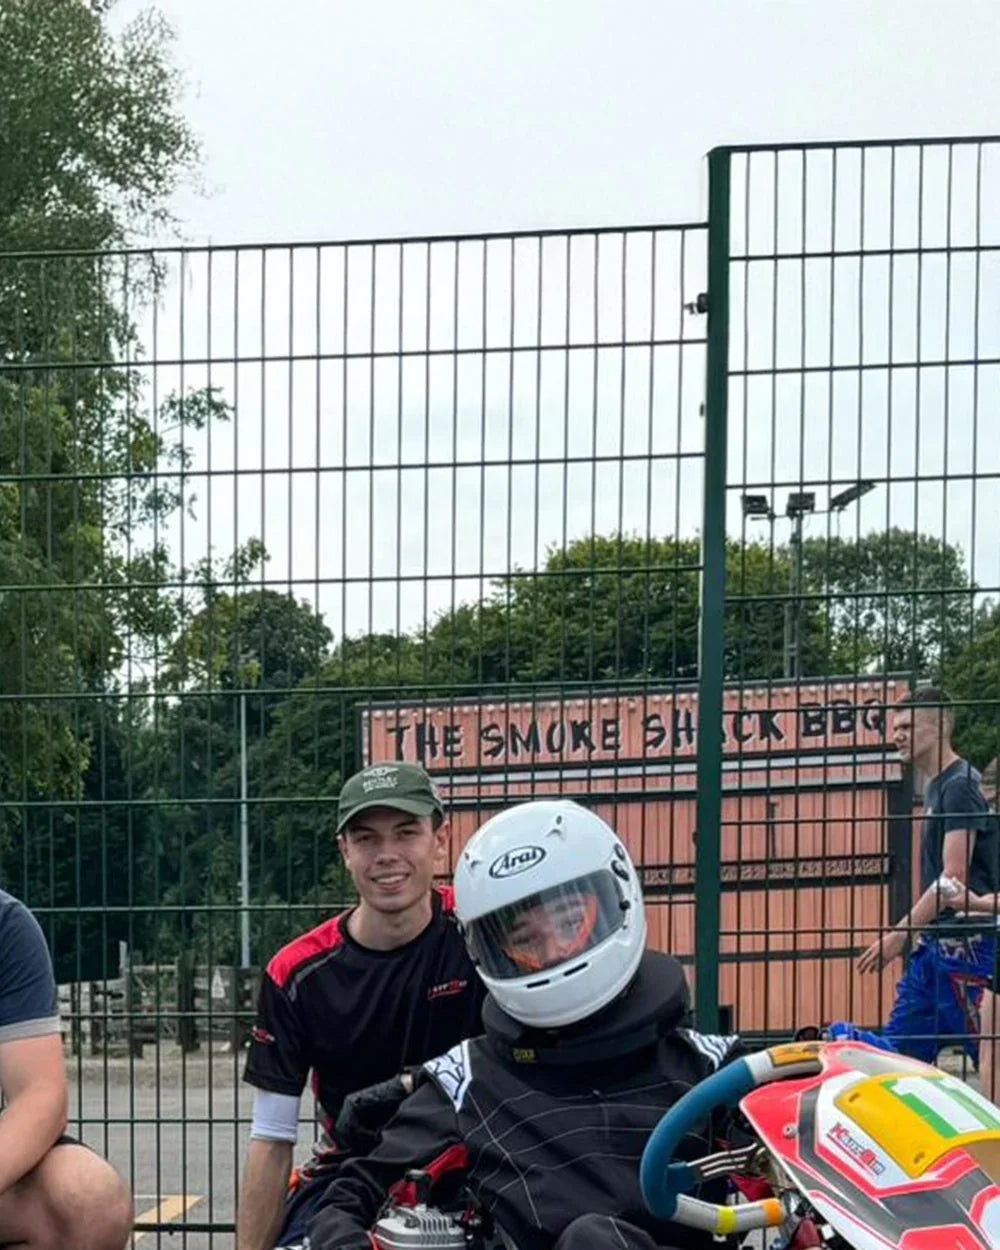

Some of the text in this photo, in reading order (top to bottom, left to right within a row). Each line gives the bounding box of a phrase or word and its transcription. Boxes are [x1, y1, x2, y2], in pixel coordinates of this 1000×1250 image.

[387, 698, 888, 762] THE SMOKE SHCK BBQ
[493, 847, 541, 876] Arai
